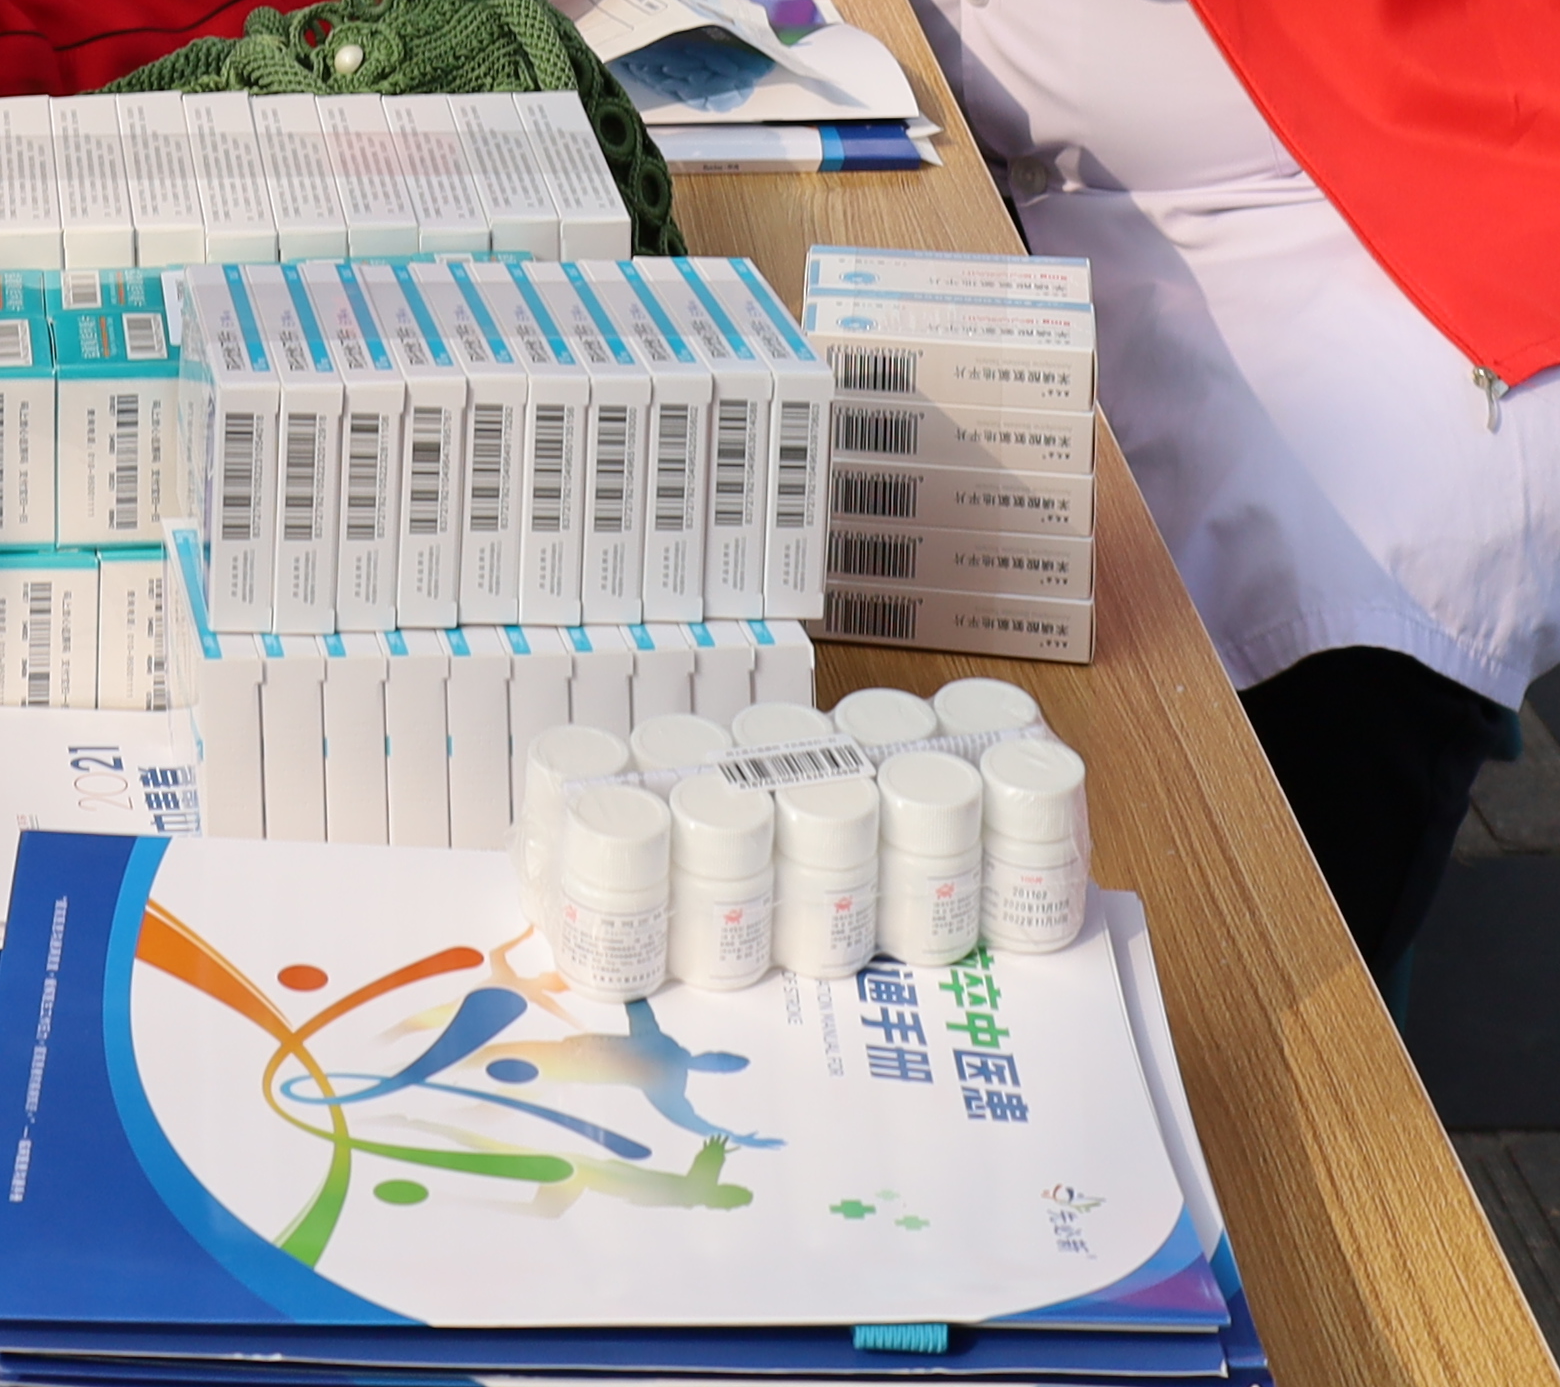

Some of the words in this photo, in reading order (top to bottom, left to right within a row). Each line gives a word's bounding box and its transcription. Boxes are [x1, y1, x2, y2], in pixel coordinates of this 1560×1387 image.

[953, 365, 1071, 385] 苯磺酸氨氯地平片
[953, 426, 1072, 448] 苯磺酸氨氯地平片
[954, 491, 1070, 511] 苯磺酸氨氯地平片
[953, 552, 1069, 573] 苯磺酸氨氯地平片
[953, 613, 1069, 634] 苯磺酸氨氯地平片
[67, 745, 133, 811] 2021
[1012, 887, 1047, 899] 201102
[781, 971, 797, 985] OF
[783, 987, 802, 1024] STROKE
[814, 980, 833, 1010] ATION
[856, 957, 933, 1084] 通手册
[817, 1012, 839, 1055] MANUAL
[824, 1057, 843, 1076] FOR
